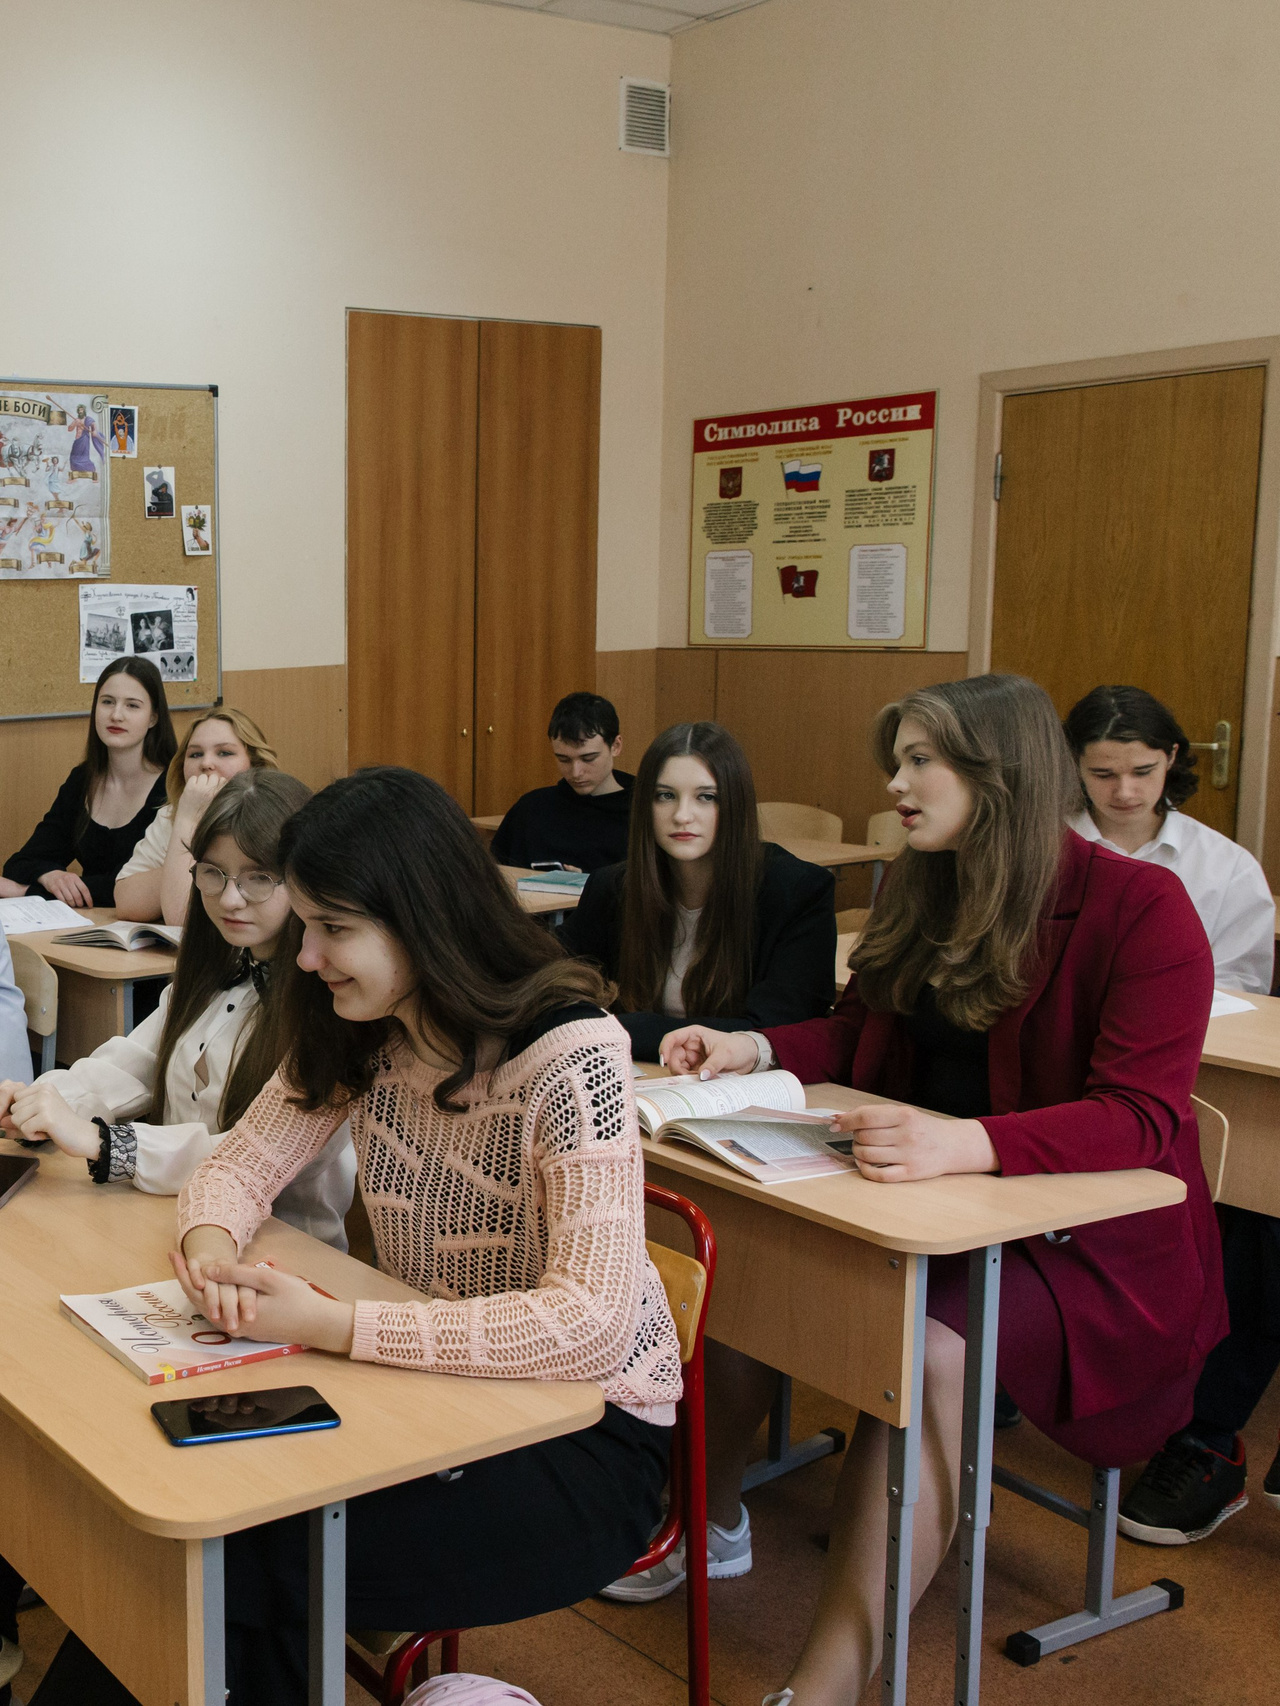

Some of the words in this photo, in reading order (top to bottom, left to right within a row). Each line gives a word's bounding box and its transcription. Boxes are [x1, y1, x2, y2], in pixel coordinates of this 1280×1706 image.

[13, 401, 47, 418] БОГИ
[703, 416, 820, 443] Символика
[835, 404, 923, 428] России
